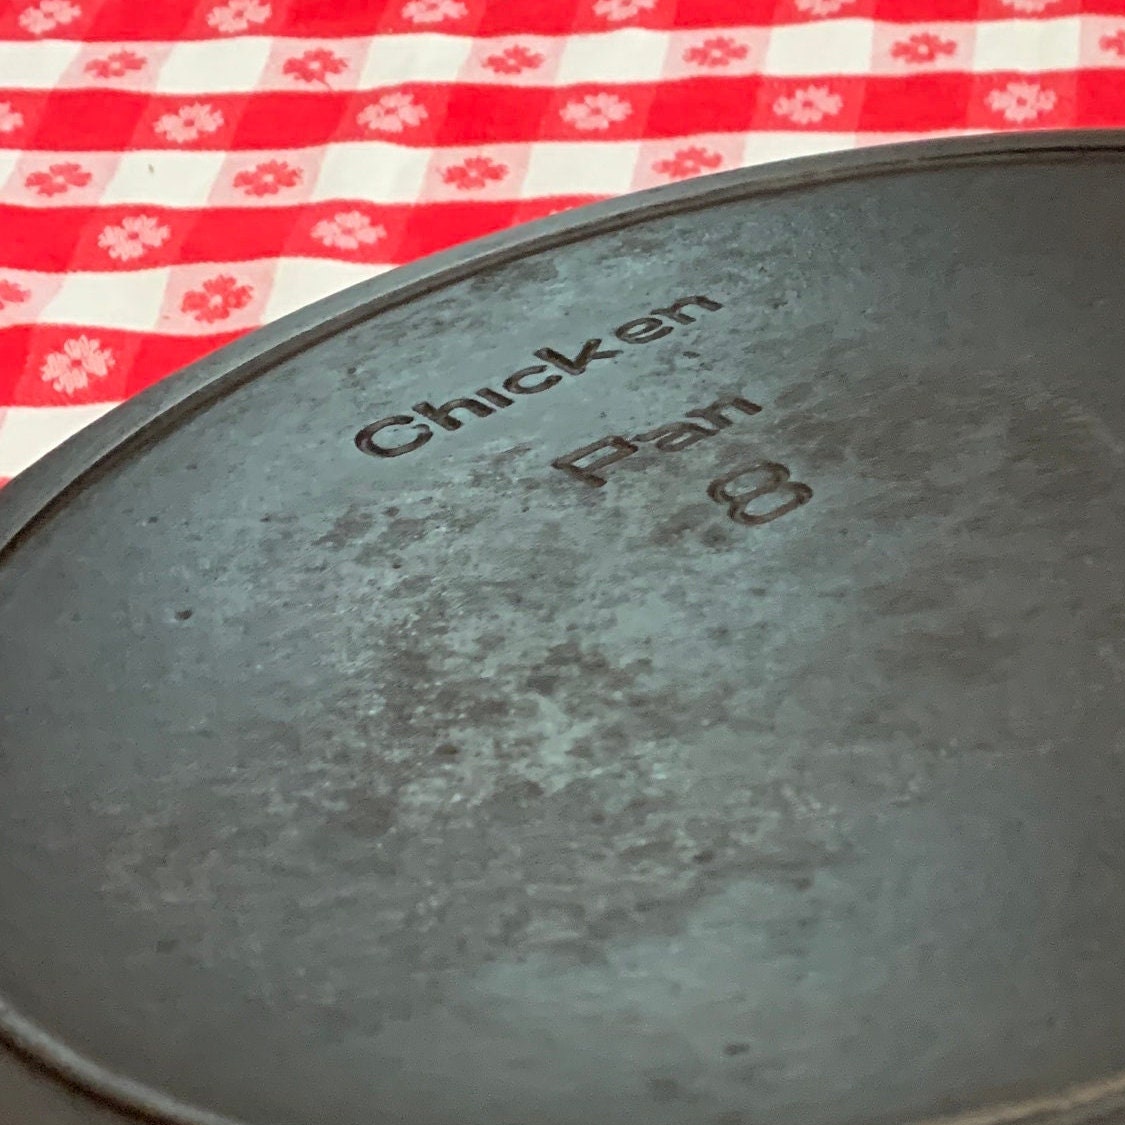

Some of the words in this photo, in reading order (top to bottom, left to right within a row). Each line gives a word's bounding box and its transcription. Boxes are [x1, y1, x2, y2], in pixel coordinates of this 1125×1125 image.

[354, 294, 724, 458] Chicken
[551, 396, 762, 487] Pan
[707, 459, 813, 525] 8
